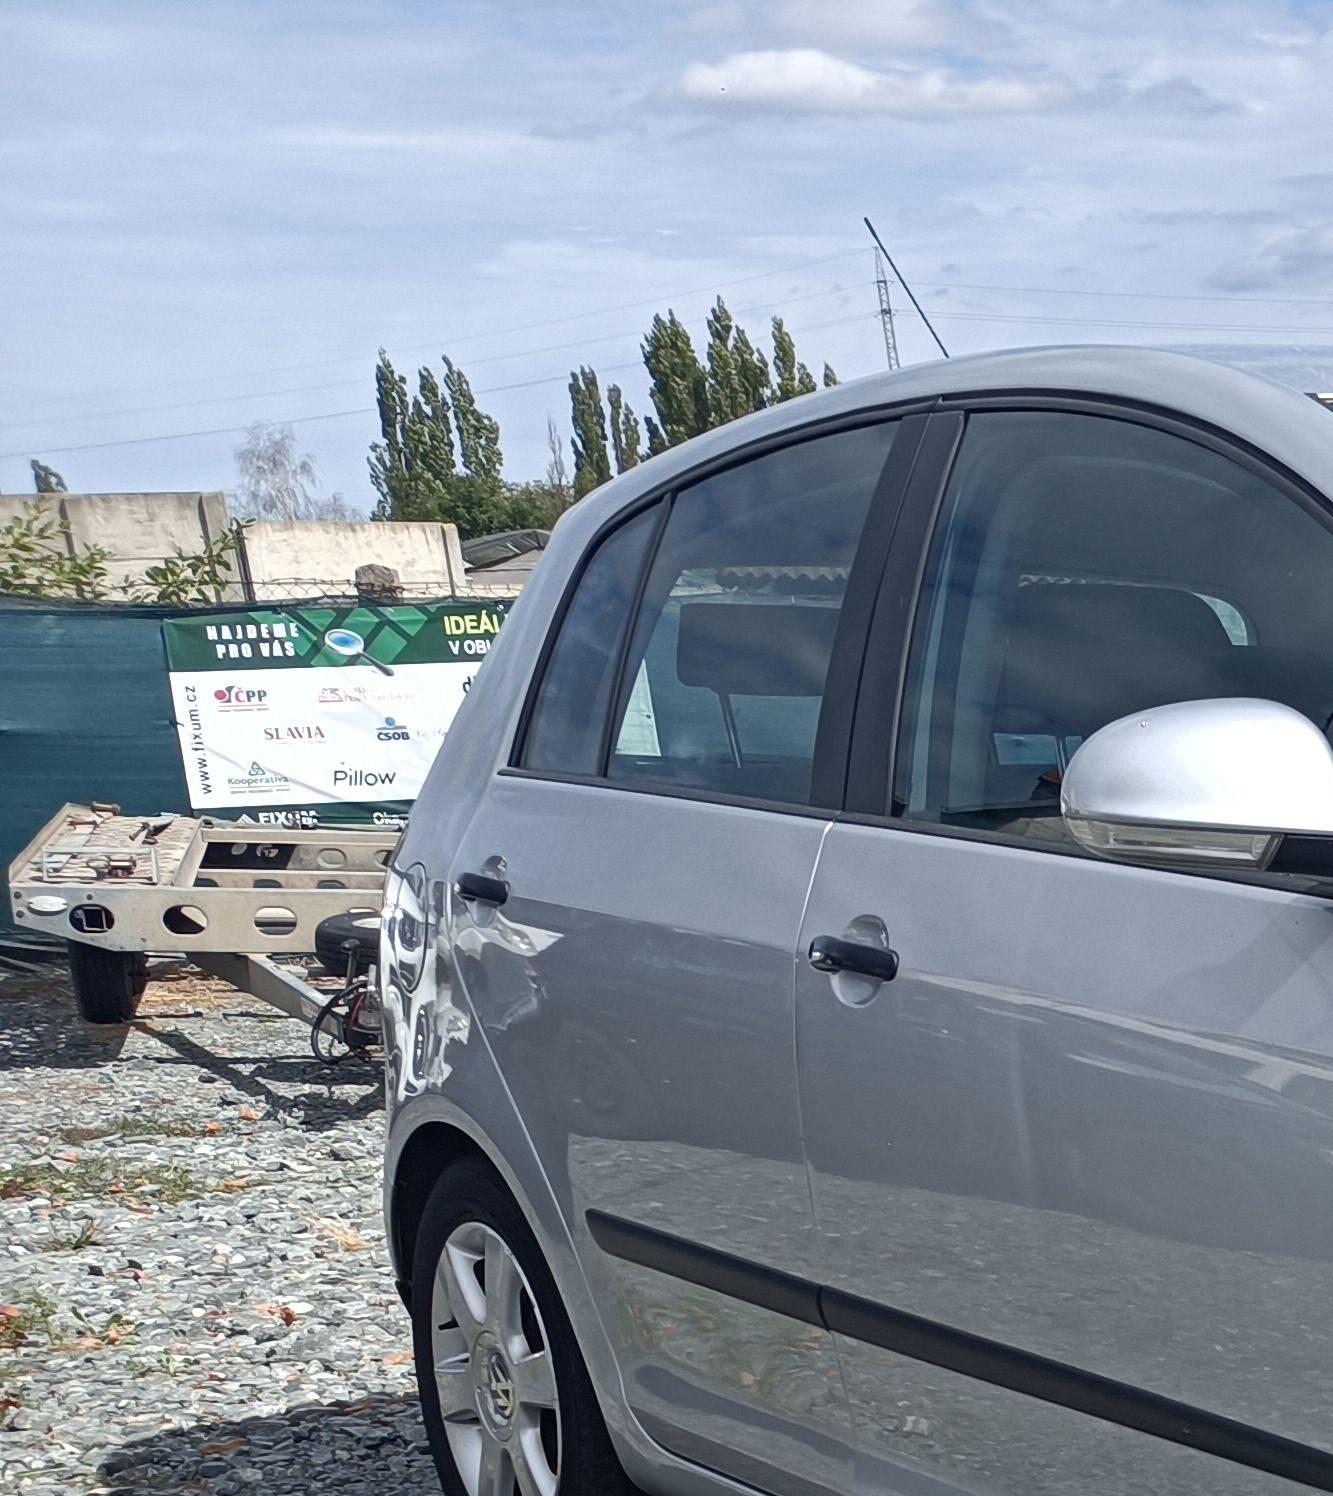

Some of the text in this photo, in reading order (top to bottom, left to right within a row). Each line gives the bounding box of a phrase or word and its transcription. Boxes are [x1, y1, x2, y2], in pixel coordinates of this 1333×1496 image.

[206, 623, 299, 640] NAJDEME
[216, 639, 295, 659] PRO VÁS
[448, 640, 460, 655] V
[234, 687, 267, 703] ČPP
[185, 685, 212, 794] www.fixum.cz
[263, 725, 325, 741] SLAVIA
[228, 775, 289, 787] Kooperativa
[333, 768, 396, 786] Pillow
